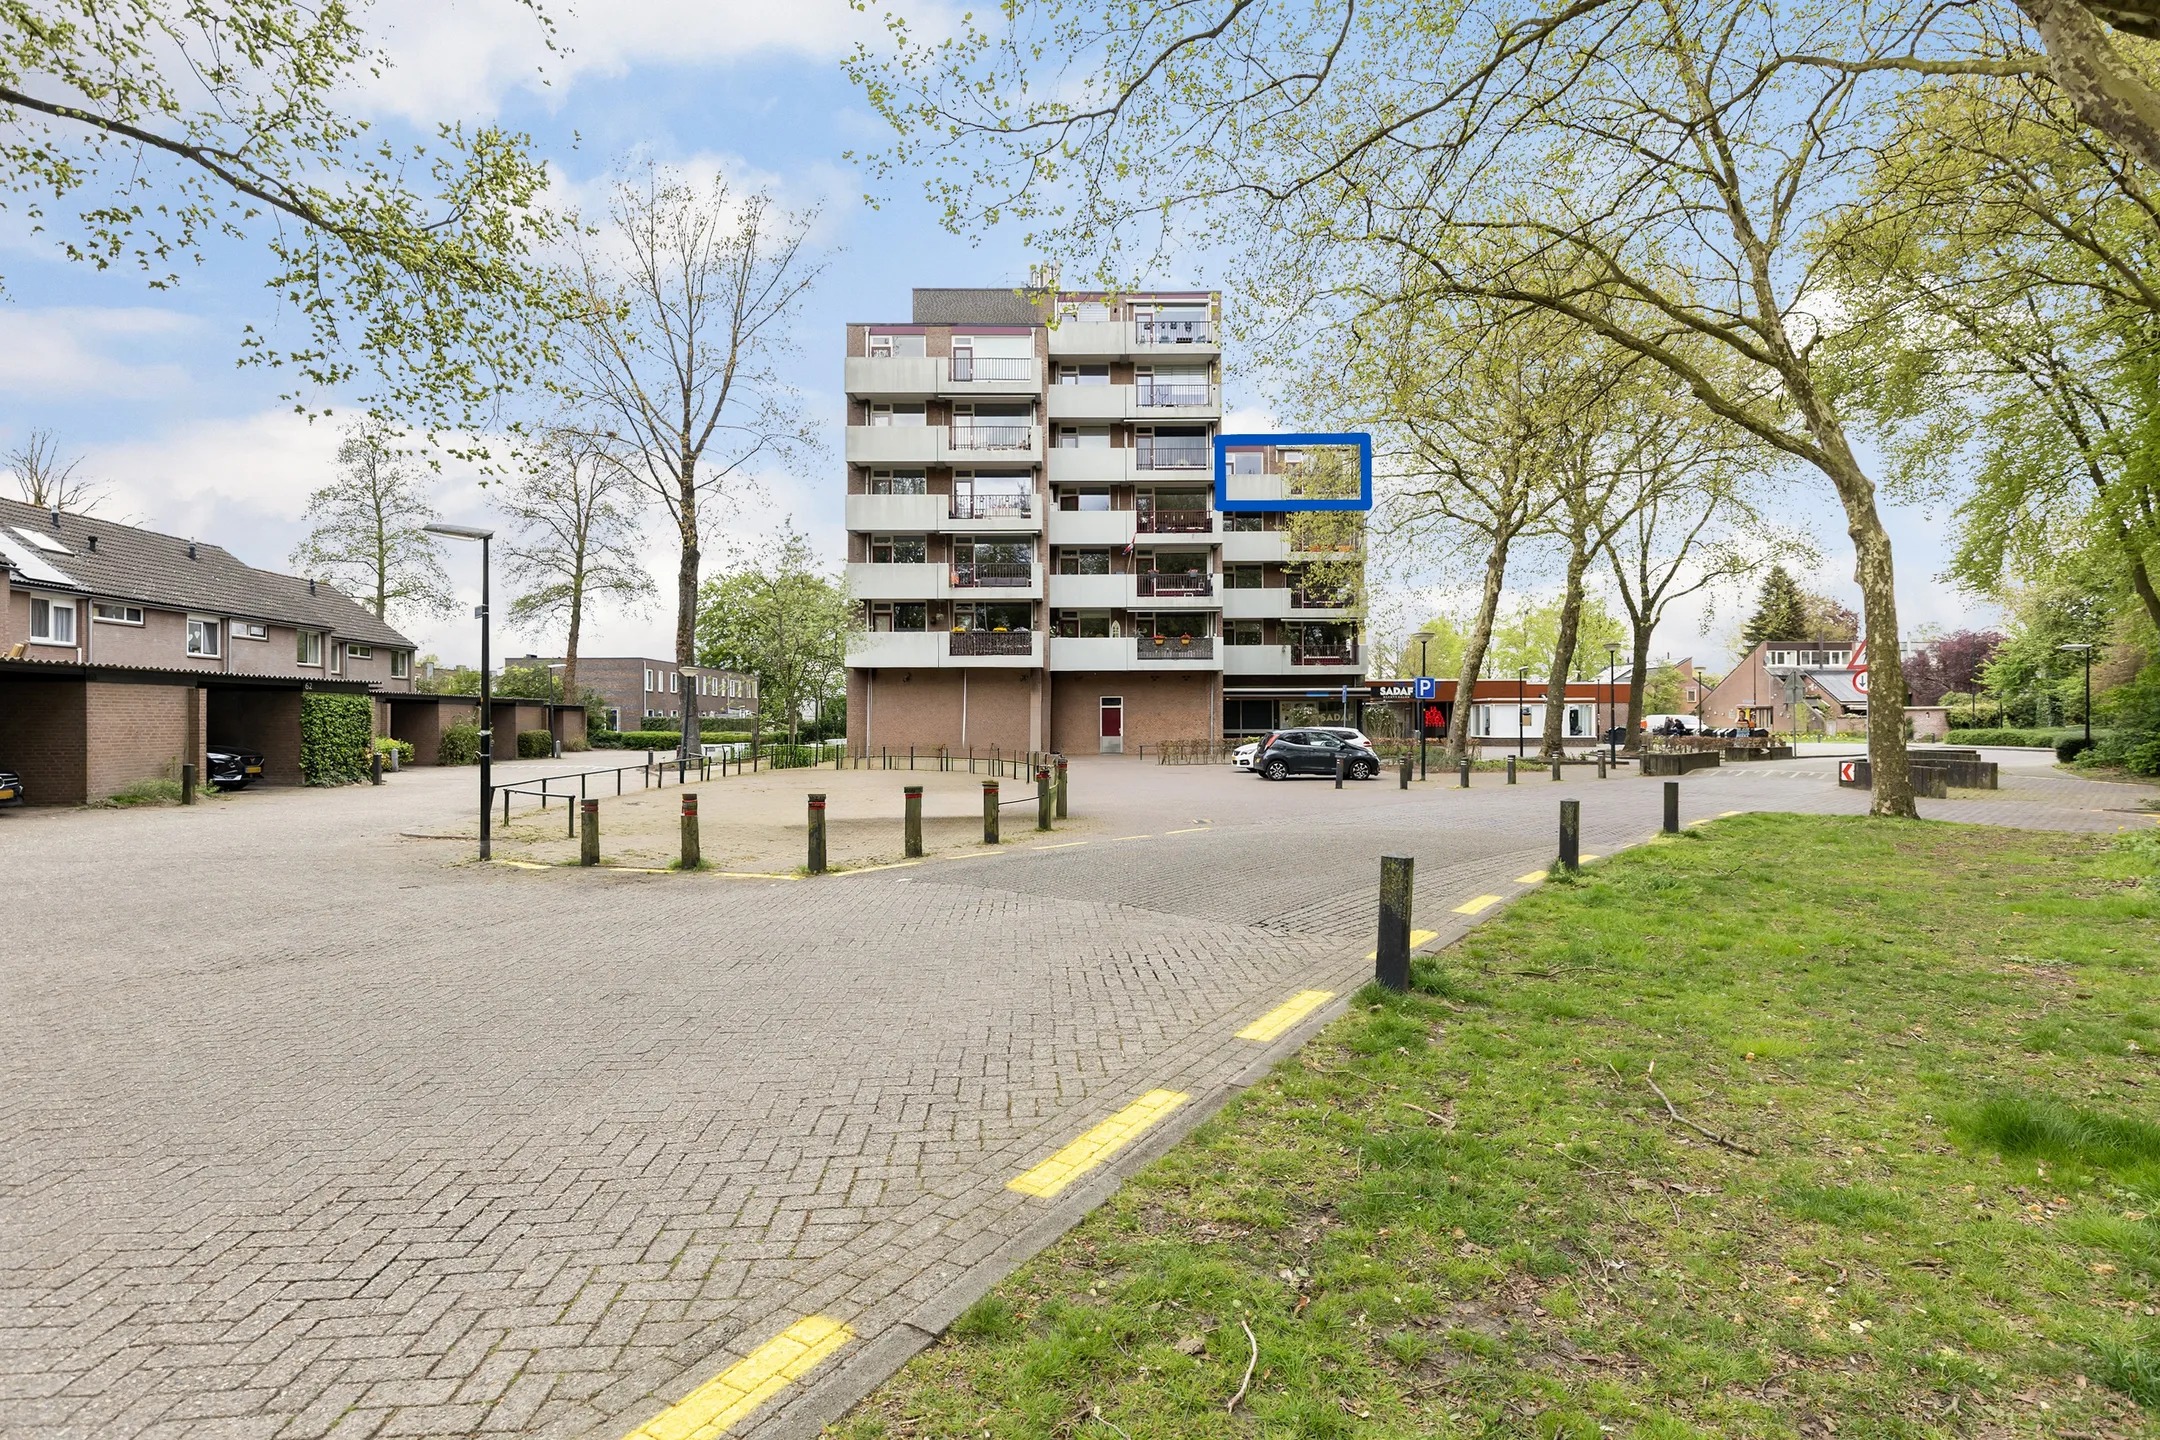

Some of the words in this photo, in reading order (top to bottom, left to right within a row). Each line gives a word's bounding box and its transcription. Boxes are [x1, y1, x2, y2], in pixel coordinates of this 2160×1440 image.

[1379, 686, 1414, 696] SADAF
[1420, 679, 1431, 696] P
[1320, 713, 1354, 722] SADAF
